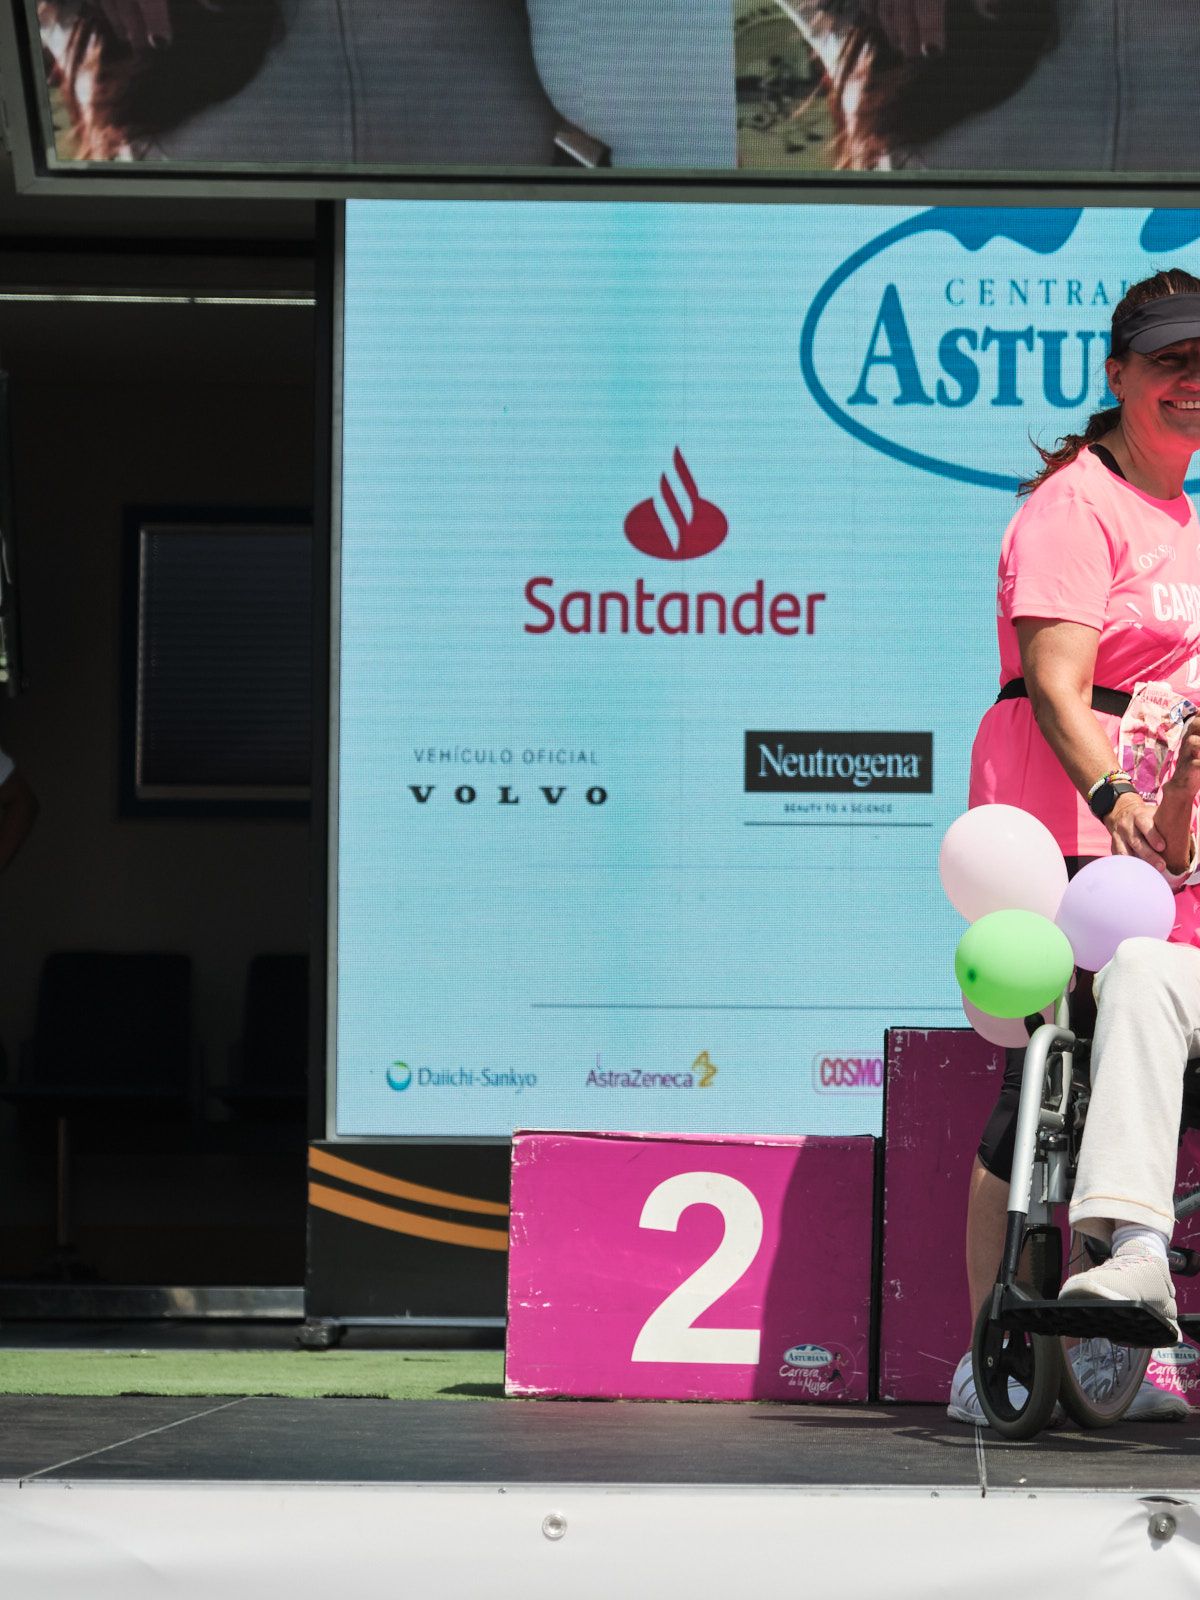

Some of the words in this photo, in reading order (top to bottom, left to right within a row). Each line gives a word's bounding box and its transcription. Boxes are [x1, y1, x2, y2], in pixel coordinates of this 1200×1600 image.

[523, 576, 826, 635] Santander
[413, 746, 513, 765] VEHÍCULO
[521, 749, 602, 765] OFICIAL
[757, 743, 922, 788] Neutrogena
[407, 784, 609, 806] VOLVO
[783, 803, 821, 814] BEAUTY
[826, 803, 837, 813] TO
[850, 803, 893, 814] SCIENCE
[417, 1067, 538, 1093] Daiichi-Sankyo
[586, 1068, 694, 1089] AstraZeneca
[631, 1171, 764, 1365] 2
[788, 1352, 829, 1362] ASTURIANA
[1156, 1350, 1197, 1360] ASTURIANA
[779, 1364, 820, 1377] Carrera
[1146, 1361, 1188, 1375] Carrera
[788, 1378, 796, 1387] de
[802, 1376, 834, 1396] Mujer
